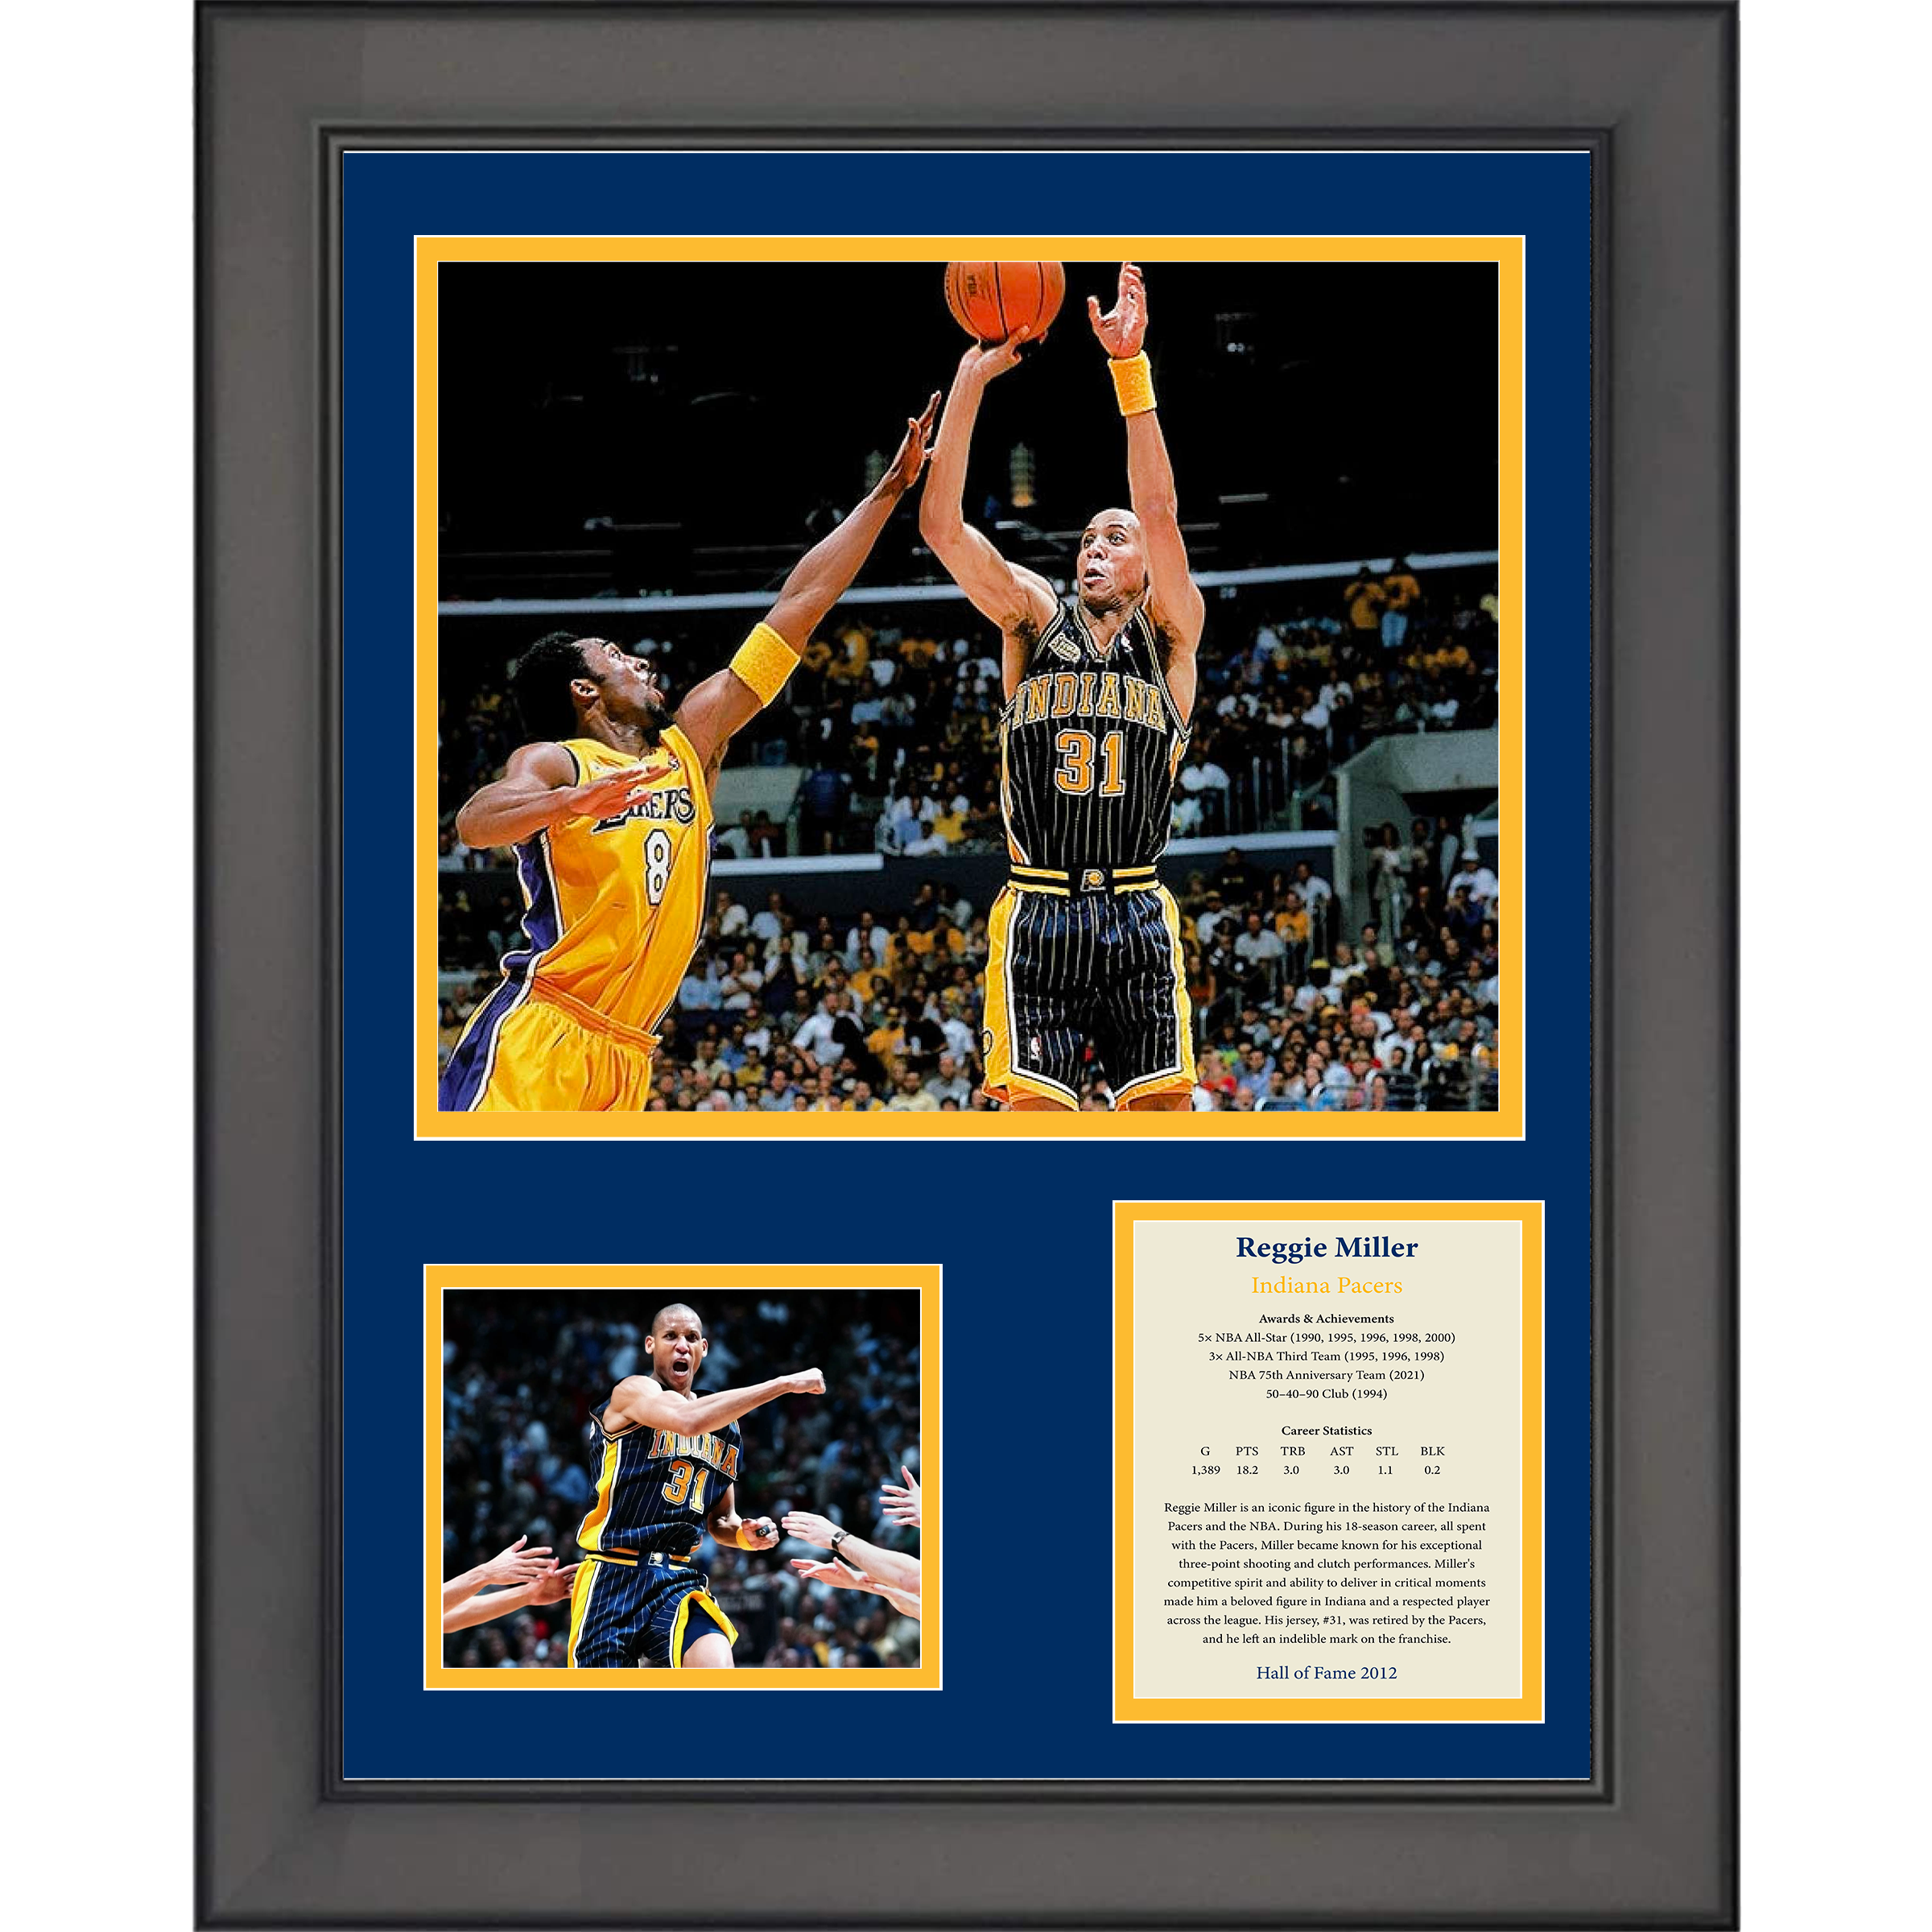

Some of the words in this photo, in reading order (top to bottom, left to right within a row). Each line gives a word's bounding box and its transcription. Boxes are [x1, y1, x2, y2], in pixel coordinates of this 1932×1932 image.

[1012, 672, 1167, 733] INDIANA
[1055, 728, 1126, 797] 31
[644, 828, 672, 906] 8
[1236, 1236, 1327, 1265] Reggie
[1334, 1235, 1419, 1258] Miller
[1251, 1275, 1331, 1294] Indiana
[1337, 1276, 1403, 1294] Pacers
[1258, 1313, 1301, 1324] Awards
[1302, 1313, 1314, 1324] &
[1315, 1313, 1395, 1324] Achievements
[1215, 1332, 1243, 1343] NBA
[1244, 1331, 1288, 1343] All-Star
[1290, 1331, 1324, 1345] (1990,
[1327, 1332, 1357, 1344] 1995,
[1360, 1332, 1389, 1344] 1996,
[1393, 1332, 1422, 1344] 1998,
[1424, 1331, 1455, 1345] 2000)
[1225, 1351, 1274, 1361] All-NBA
[1276, 1350, 1308, 1361] Third
[1311, 1351, 1341, 1361] Team
[1344, 1350, 1378, 1364] (1995,
[1382, 1351, 1411, 1363] 1996,
[1414, 1350, 1445, 1364] 1998)
[1228, 1369, 1257, 1380] NBA
[1258, 1369, 1283, 1380] 75th
[1285, 1370, 1354, 1383] Anniversary
[1355, 1369, 1386, 1380] Team
[1389, 1369, 1425, 1382] (2021)
[1322, 1388, 1349, 1399] Club
[1352, 1388, 1388, 1401] (1994)
[1281, 1426, 1321, 1436] Career
[1322, 1425, 1373, 1436] Statistics
[647, 1429, 740, 1481] INDIANA
[1200, 1446, 1211, 1456] G
[1235, 1446, 1259, 1456] PTS
[1279, 1446, 1306, 1456] TRB
[1329, 1446, 1355, 1456] AST
[1375, 1446, 1399, 1456] STL
[1420, 1446, 1446, 1456] BLK
[1191, 1465, 1221, 1476] 1,389
[1236, 1465, 1259, 1476] 18.2
[1283, 1465, 1300, 1475] 3.0
[1333, 1465, 1350, 1476] 3.0
[1378, 1465, 1393, 1475] 1.1
[1424, 1465, 1441, 1476] 0.2
[661, 1457, 710, 1514] 31
[1164, 1502, 1201, 1516] Reggie
[1203, 1501, 1238, 1513] Miller
[1240, 1502, 1249, 1513] is
[1251, 1505, 1265, 1513] an
[1268, 1502, 1302, 1513] iconic
[1304, 1501, 1335, 1516] figure
[1338, 1502, 1350, 1513] in
[1352, 1501, 1370, 1513] the
[1373, 1501, 1411, 1516] history
[1414, 1501, 1426, 1513] of
[1427, 1501, 1445, 1513] the
[1447, 1501, 1490, 1513] Indiana
[1167, 1521, 1203, 1531] Pacers
[1205, 1521, 1227, 1531] and
[1228, 1521, 1247, 1531] the
[1249, 1521, 1280, 1531] NBA.
[1283, 1521, 1323, 1534] During
[1326, 1521, 1342, 1531] his
[1345, 1521, 1399, 1531] 18-season
[1401, 1523, 1438, 1533] career,
[1440, 1521, 1454, 1531] all
[1456, 1522, 1487, 1534] spent
[1170, 1539, 1196, 1550] with
[1199, 1539, 1216, 1550] the
[1219, 1540, 1257, 1551] Pacers,
[1260, 1539, 1294, 1550] Miller
[1297, 1539, 1339, 1550] became
[1341, 1539, 1380, 1550] known
[1381, 1539, 1398, 1550] for
[1401, 1539, 1418, 1550] his
[1419, 1539, 1483, 1553] exceptional
[1179, 1558, 1241, 1572] three-point
[1243, 1558, 1291, 1572] shooting
[1294, 1558, 1315, 1569] and
[1317, 1558, 1351, 1569] clutch
[1353, 1558, 1431, 1572] performances.
[1434, 1558, 1476, 1569] Miller's
[1167, 1578, 1232, 1591] competitive
[1234, 1578, 1264, 1591] spirit
[1265, 1577, 1287, 1587] and
[1289, 1577, 1324, 1591] ability
[1326, 1579, 1338, 1588] to
[1340, 1577, 1378, 1587] deliver
[1380, 1578, 1392, 1587] in
[1394, 1577, 1432, 1587] critical
[1435, 1579, 1486, 1588] moments
[1163, 1596, 1194, 1607] made
[1196, 1596, 1219, 1606] him
[1221, 1599, 1228, 1607] a
[1230, 1596, 1274, 1607] beloved
[1276, 1596, 1308, 1609] figure
[1310, 1596, 1322, 1606] in
[1324, 1596, 1367, 1607] Indiana
[1368, 1596, 1390, 1607] and
[1393, 1599, 1400, 1607] a
[1402, 1596, 1454, 1609] respected
[1456, 1596, 1491, 1609] player
[1166, 1617, 1201, 1625] across
[1203, 1614, 1221, 1625] the
[1224, 1614, 1261, 1629] league.
[1264, 1615, 1284, 1625] His
[1285, 1615, 1320, 1629] jersey,
[1323, 1615, 1346, 1626] #31,
[1348, 1617, 1370, 1625] was
[1372, 1614, 1409, 1625] retired
[1411, 1614, 1426, 1628] by
[1427, 1614, 1446, 1625] the
[1448, 1615, 1487, 1626] Pacers,
[1202, 1633, 1224, 1644] and
[1226, 1633, 1240, 1644] he
[1242, 1633, 1260, 1644] left
[1262, 1636, 1276, 1644] an
[1279, 1633, 1327, 1644] indelible
[1329, 1633, 1359, 1644] mark
[1360, 1636, 1375, 1644] on
[1377, 1633, 1396, 1644] the
[1398, 1633, 1451, 1644] franchise.
[1256, 1665, 1290, 1680] Hall
[1294, 1665, 1312, 1680] of
[1314, 1666, 1356, 1680] Fame
[1360, 1666, 1397, 1680] 2012
